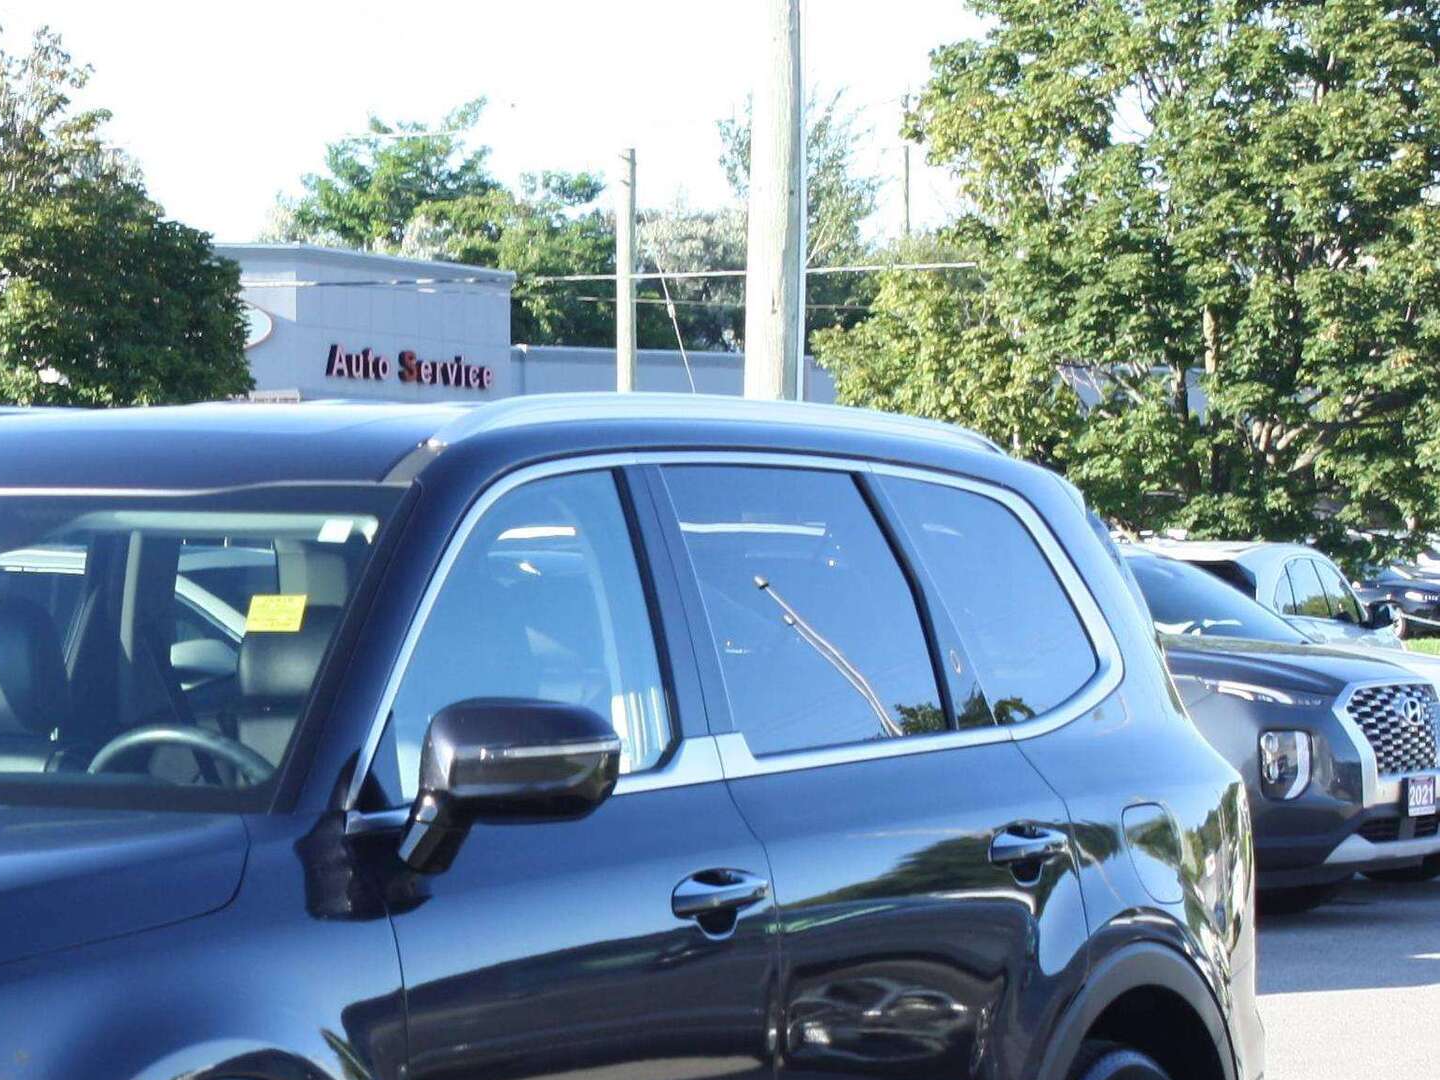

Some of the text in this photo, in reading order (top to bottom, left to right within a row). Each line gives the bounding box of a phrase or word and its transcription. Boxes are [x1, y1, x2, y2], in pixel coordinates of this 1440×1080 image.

[326, 344, 494, 388] Auto Service
[1409, 784, 1433, 805] 2021
